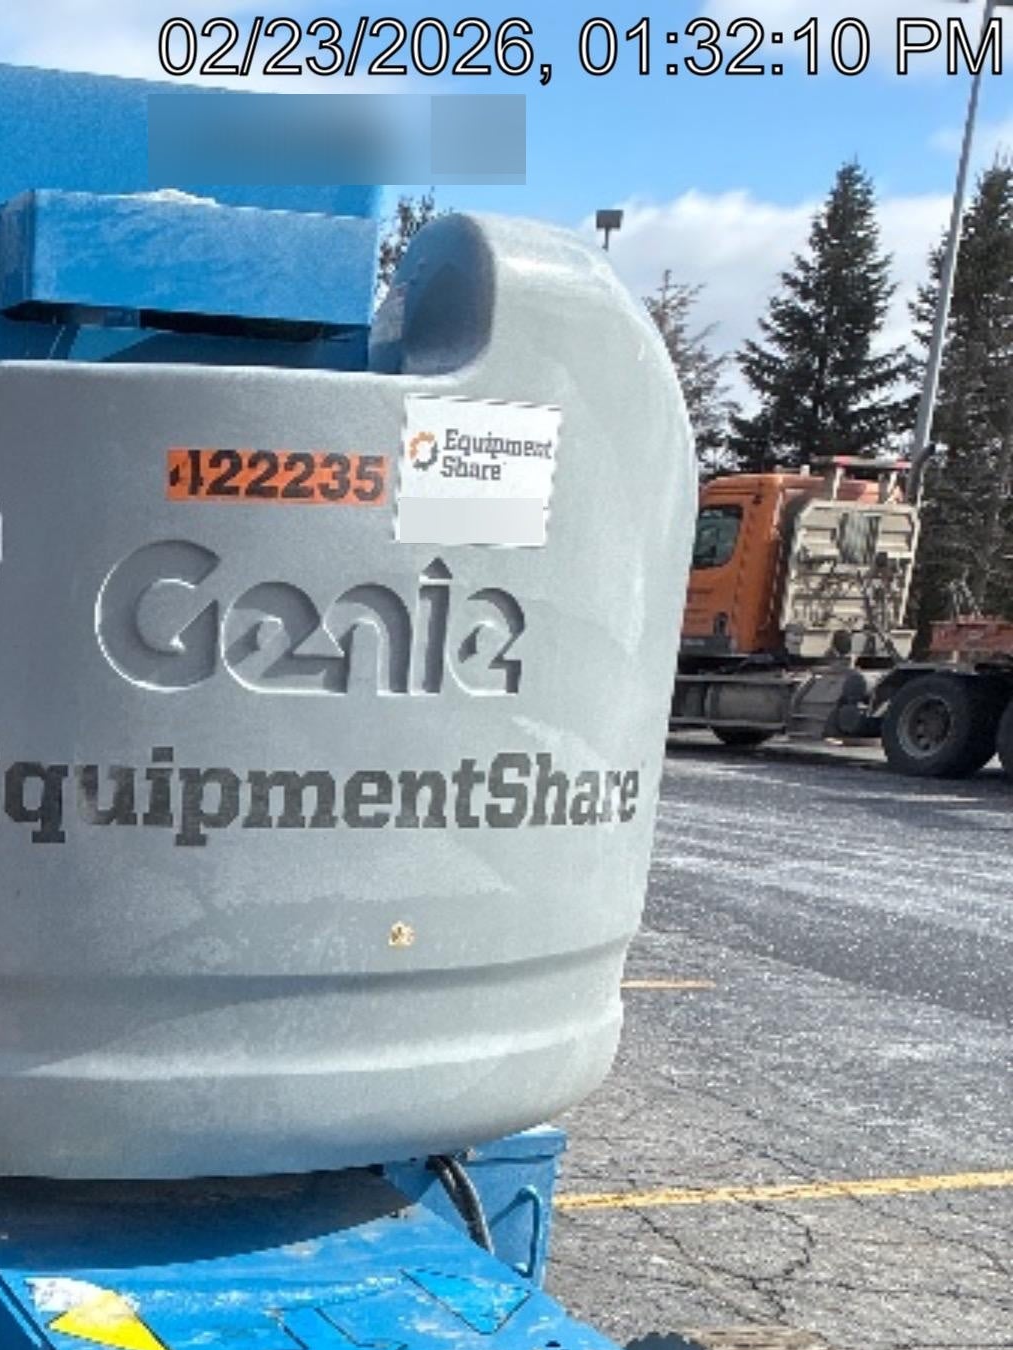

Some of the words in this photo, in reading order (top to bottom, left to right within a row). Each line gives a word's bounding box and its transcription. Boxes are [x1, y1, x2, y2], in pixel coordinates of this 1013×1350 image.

[442, 428, 553, 460] Equipment
[440, 455, 502, 481] Share
[94, 538, 526, 696] Genie
